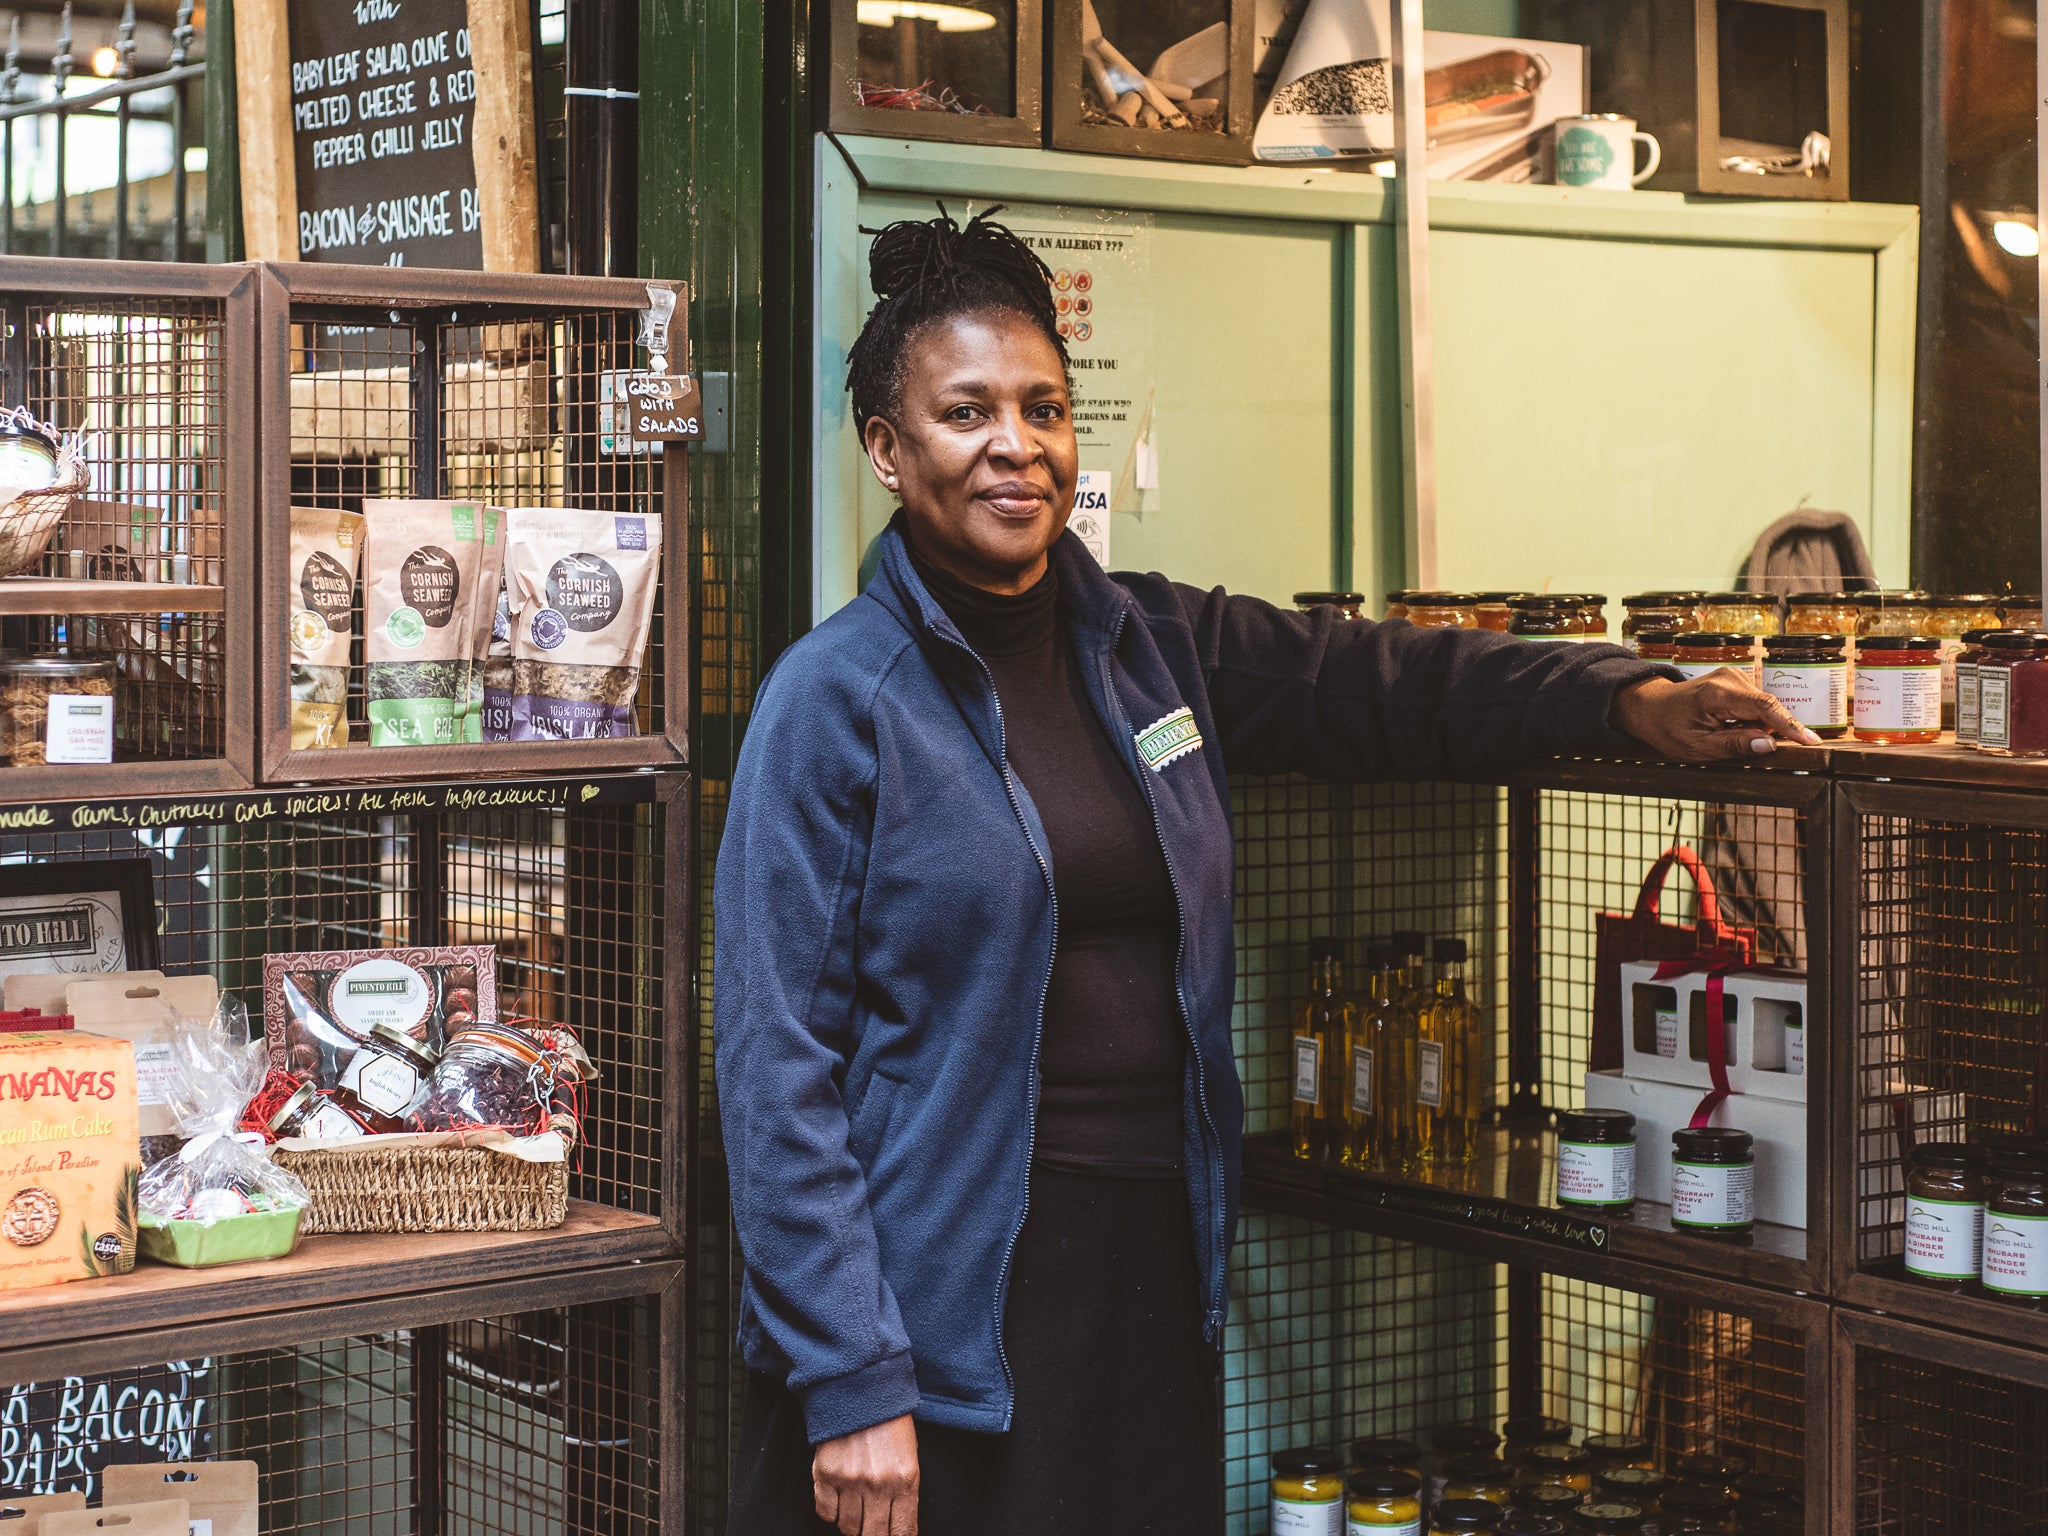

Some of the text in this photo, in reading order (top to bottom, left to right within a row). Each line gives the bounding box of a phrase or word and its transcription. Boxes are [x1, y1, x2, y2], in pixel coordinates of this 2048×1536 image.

[293, 60, 325, 95] BABY
[327, 49, 361, 88] LEAF
[411, 30, 450, 69] OLIVE
[455, 28, 473, 60] OI
[295, 69, 477, 133] MELTED CHEESE & RED
[313, 114, 464, 170] PEPPER CHILLI JELLY
[300, 205, 356, 255] BACON
[377, 189, 454, 244] SAUSAGE
[460, 187, 482, 233] BA
[1018, 237, 1124, 251] OT AN ALLERGY ???
[1097, 359, 1118, 370] YOU
[628, 380, 672, 395] GOOD
[640, 399, 675, 412] WITH
[1071, 412, 1128, 421] LLERGENS ARE
[638, 415, 699, 435] SALADS
[1078, 474, 1090, 485] pt
[308, 564, 321, 574] The
[407, 561, 421, 571] The
[311, 576, 349, 592] CORNISH
[410, 572, 454, 587] CORNISH
[558, 577, 611, 594] CORNISH
[412, 588, 453, 603] SEAWEED
[558, 592, 611, 609] SEAWEED
[570, 609, 613, 622] Company
[492, 696, 512, 707] 100%
[309, 708, 330, 721] 100%
[551, 705, 603, 719] 100% ORGAN
[388, 716, 454, 740] SEA GRE
[531, 714, 574, 739] IRISH
[235, 797, 278, 824] and
[358, 792, 386, 811] All
[390, 789, 437, 814] fresh
[34, 919, 86, 945] HILL
[350, 981, 405, 992] PIMENTO HILL
[31, 1119, 69, 1143] Rum
[72, 1111, 113, 1139] Cake
[8, 1162, 20, 1181] of
[21, 1154, 57, 1175] Island
[58, 1150, 100, 1171] Paradise
[1564, 1222, 1588, 1243] love
[1932, 1225, 1951, 1233] HILL
[102, 1236, 117, 1244] great
[1908, 1230, 1944, 1243] RHUBARB
[94, 1240, 121, 1254] taste
[1913, 1240, 1944, 1251] GINGER
[2013, 1241, 2033, 1249] HILL
[1907, 1246, 1945, 1260] PRESERVE
[1987, 1247, 2026, 1259] RHUBARB
[1993, 1257, 2026, 1268] GINGER
[1986, 1264, 2027, 1276] PRESERVE
[52, 1375, 207, 1458] BACON
